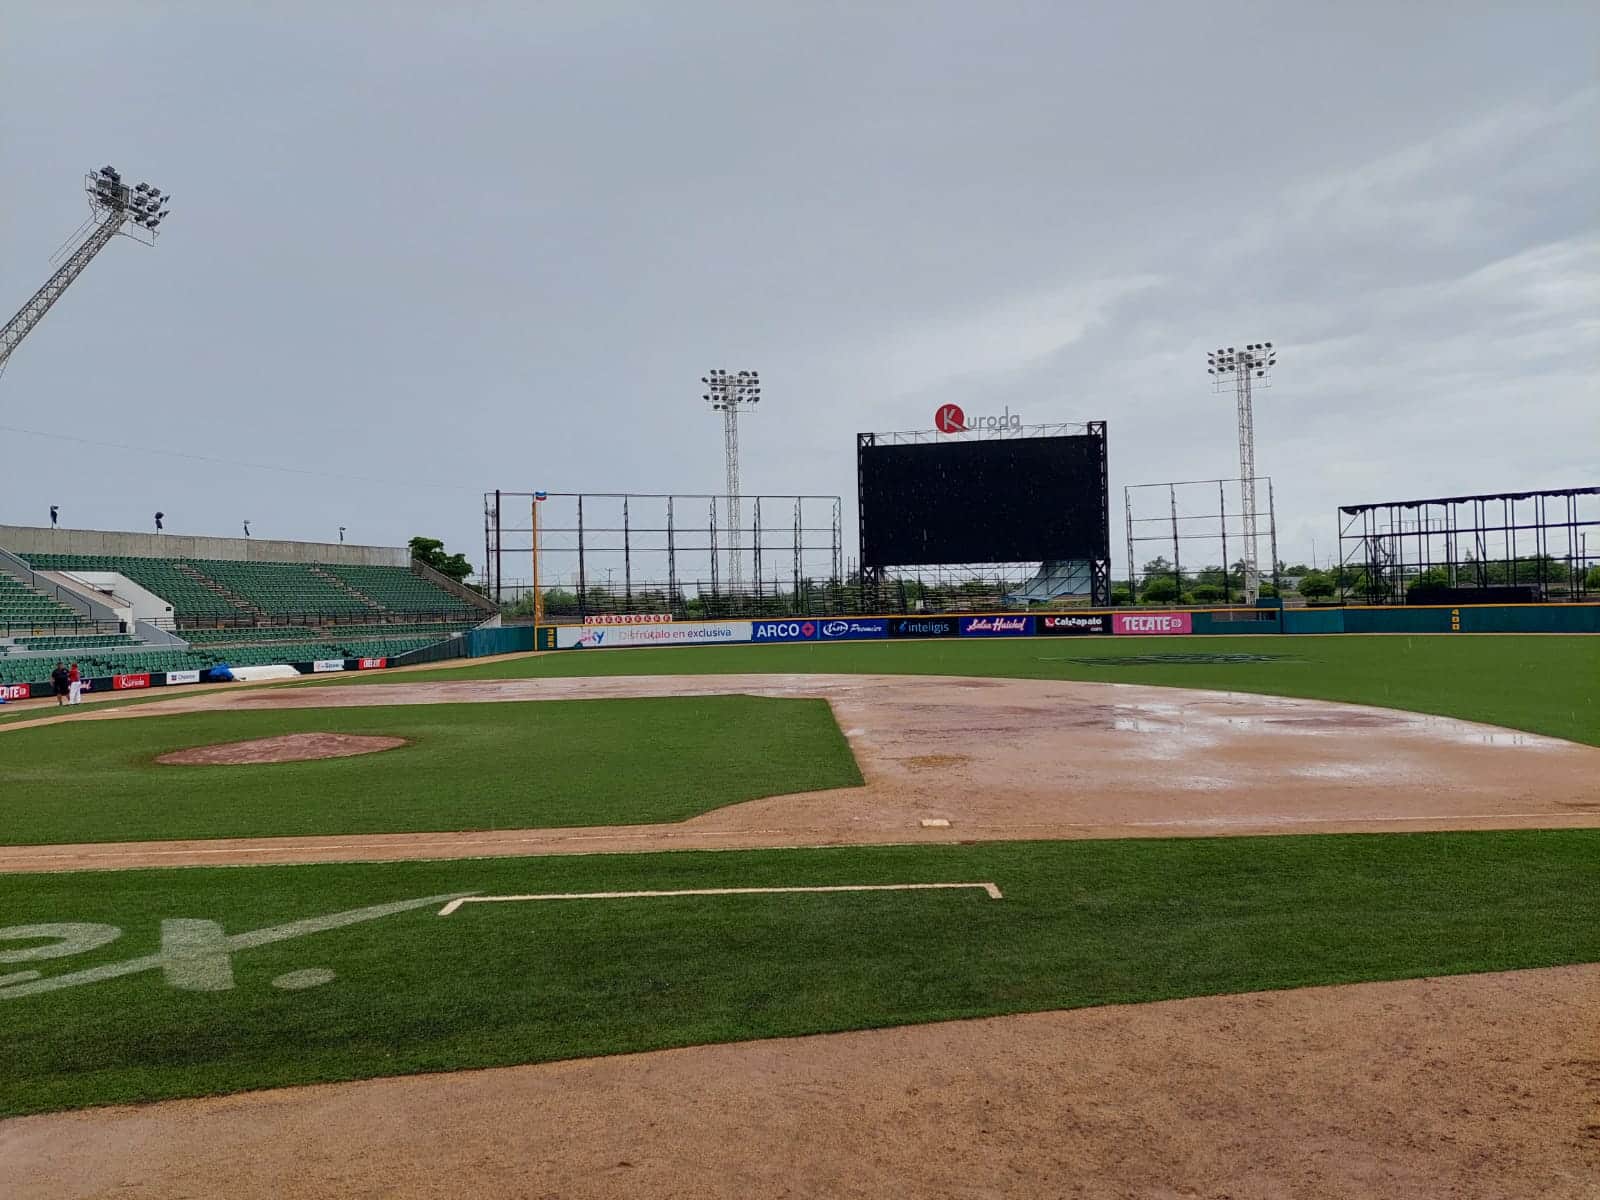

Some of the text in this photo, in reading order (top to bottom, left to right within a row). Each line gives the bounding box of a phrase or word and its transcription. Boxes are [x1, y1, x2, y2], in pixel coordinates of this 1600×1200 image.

[943, 406, 1020, 432] Kuroda
[756, 623, 800, 637] ARCO
[1122, 616, 1171, 631] TECATE
[687, 628, 732, 638] exclusiva
